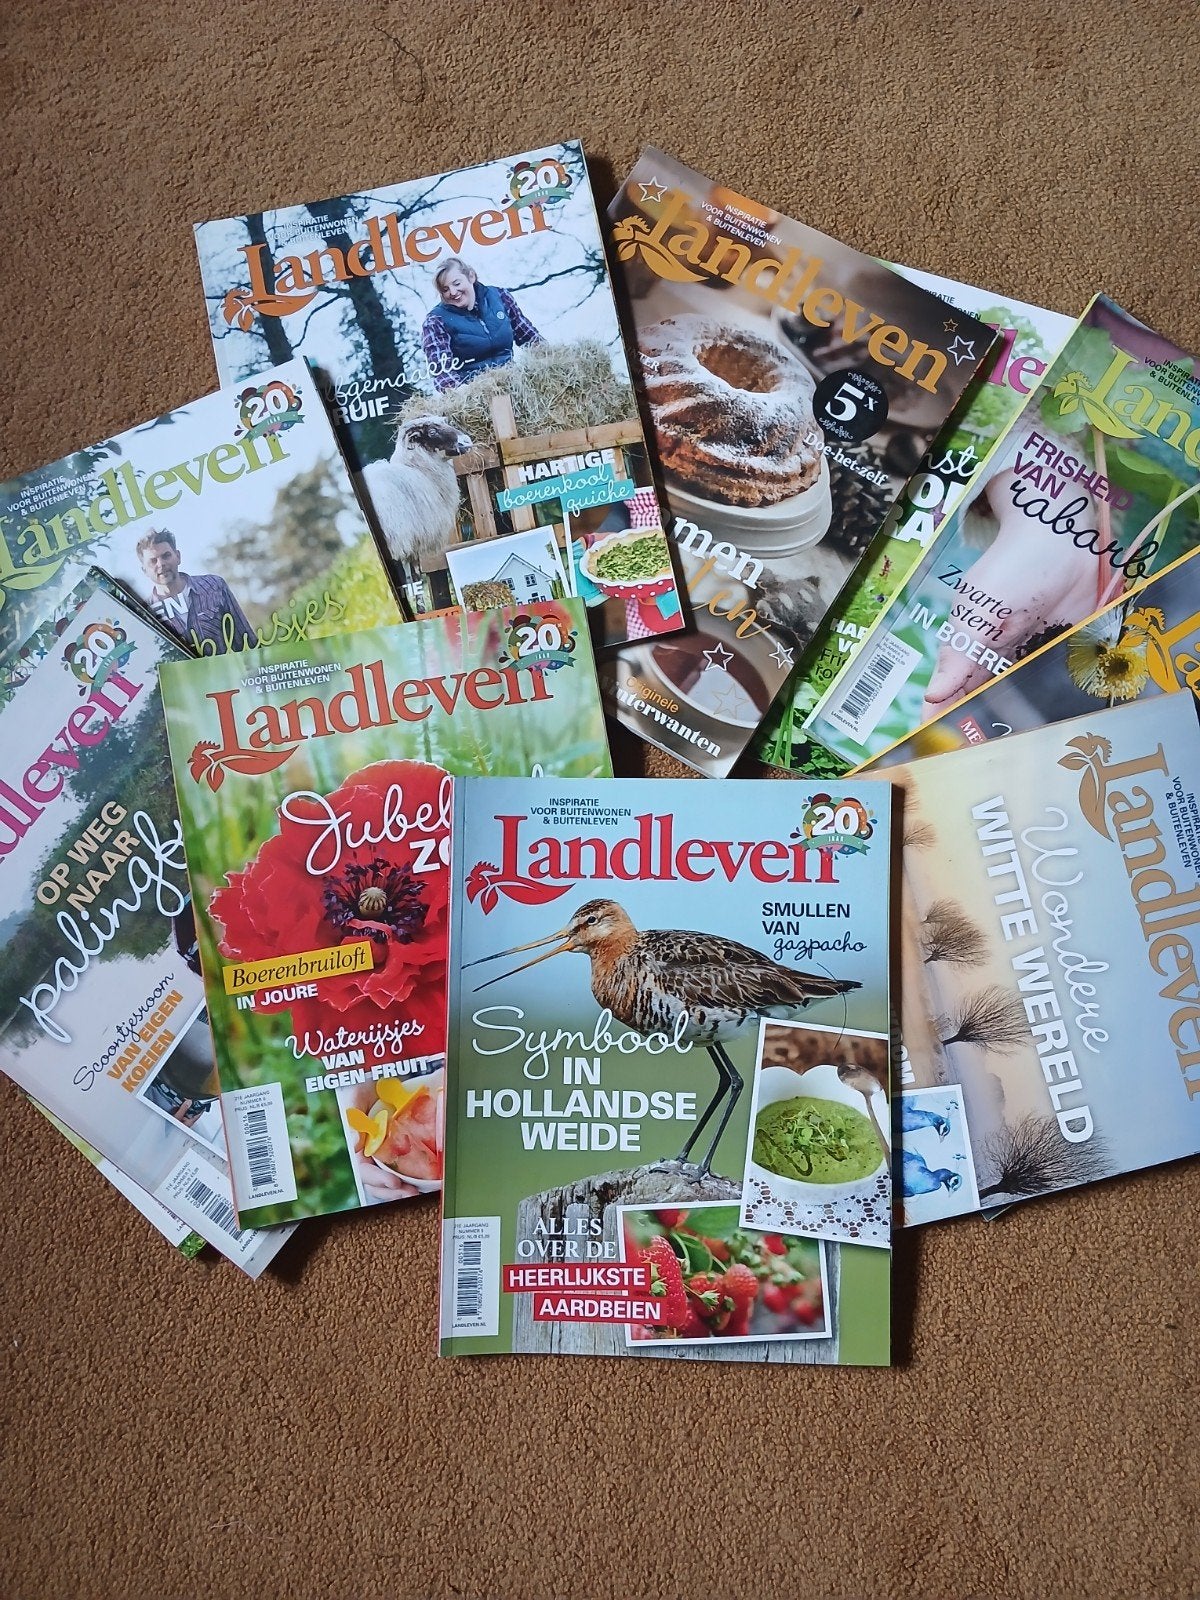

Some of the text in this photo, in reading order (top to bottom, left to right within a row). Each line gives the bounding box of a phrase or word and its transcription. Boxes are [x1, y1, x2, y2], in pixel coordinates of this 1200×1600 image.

[517, 165, 559, 197] 20
[701, 201, 783, 246] VOOR BUITENWONEN
[705, 214, 767, 248] & BUITENLEVEN
[724, 203, 768, 229] INSPIRATIE
[237, 203, 553, 316] Landleven
[640, 186, 949, 395] Landleven
[1144, 356, 1169, 377] VOOR
[1149, 370, 1158, 379] &
[246, 389, 289, 426] 20
[333, 395, 390, 426] RUIF
[518, 448, 616, 483] HARTIGE
[804, 431, 889, 487] Doe-het-zelf
[1013, 452, 1067, 500] VAN
[1023, 431, 1135, 511] FRISHEID
[7, 471, 96, 513] VOOR BUITENWONEN
[20, 475, 66, 499] INSPIRATIE
[29, 484, 86, 513] BUITENLEVEN
[503, 464, 609, 509] boerenkool
[566, 479, 630, 517] quiche
[0, 433, 290, 589] Landleven
[938, 563, 1013, 620] Zwarte
[909, 602, 937, 631] IN
[935, 620, 1013, 676] BOERE
[951, 603, 1005, 642] stern
[74, 631, 116, 678] 20
[516, 623, 562, 657] 20
[241, 663, 342, 687] VOOR BUITENWONEN
[255, 674, 331, 694] & BUITENLEVEN
[258, 659, 309, 675] INSPIRATIE
[206, 659, 554, 776] Landleven
[961, 720, 983, 744] ME
[549, 798, 600, 807] INSPIRATIE
[1172, 776, 1186, 805] VOOR
[530, 806, 632, 817] VOOR BUITENWONEN
[543, 816, 618, 826] & BUITENLEVEN
[811, 805, 860, 836] 20
[1165, 792, 1193, 868] & BUITENLEVEN
[37, 800, 128, 905] OP WEG
[494, 812, 840, 906] Landleven
[66, 830, 141, 911] NAAR
[762, 901, 850, 918] SMULLEN
[761, 920, 800, 936] VAN
[1020, 806, 1111, 1054] Wondere
[773, 931, 868, 961] gazpacho
[232, 946, 366, 988] Boerenbruiloft
[971, 795, 1095, 1144] WITTE WERELD
[236, 983, 319, 1011] IN JOURE
[107, 989, 184, 1080] VAN EIGEN
[284, 1018, 426, 1060] Waterijsjes
[472, 1005, 694, 1080] Symbool
[121, 1028, 176, 1093] KOEIEN
[305, 1056, 430, 1094] EIGEN FRUIT
[320, 1049, 366, 1071] VAN
[563, 1056, 601, 1085] IN
[466, 1088, 698, 1121] HOLLANDSE
[521, 1122, 642, 1152] WEIDE
[532, 1217, 602, 1236] ALLES
[517, 1239, 617, 1260] OVER DE
[509, 1266, 646, 1288] HEERLIJKSTE
[539, 1298, 662, 1320] AARDBEIEN
